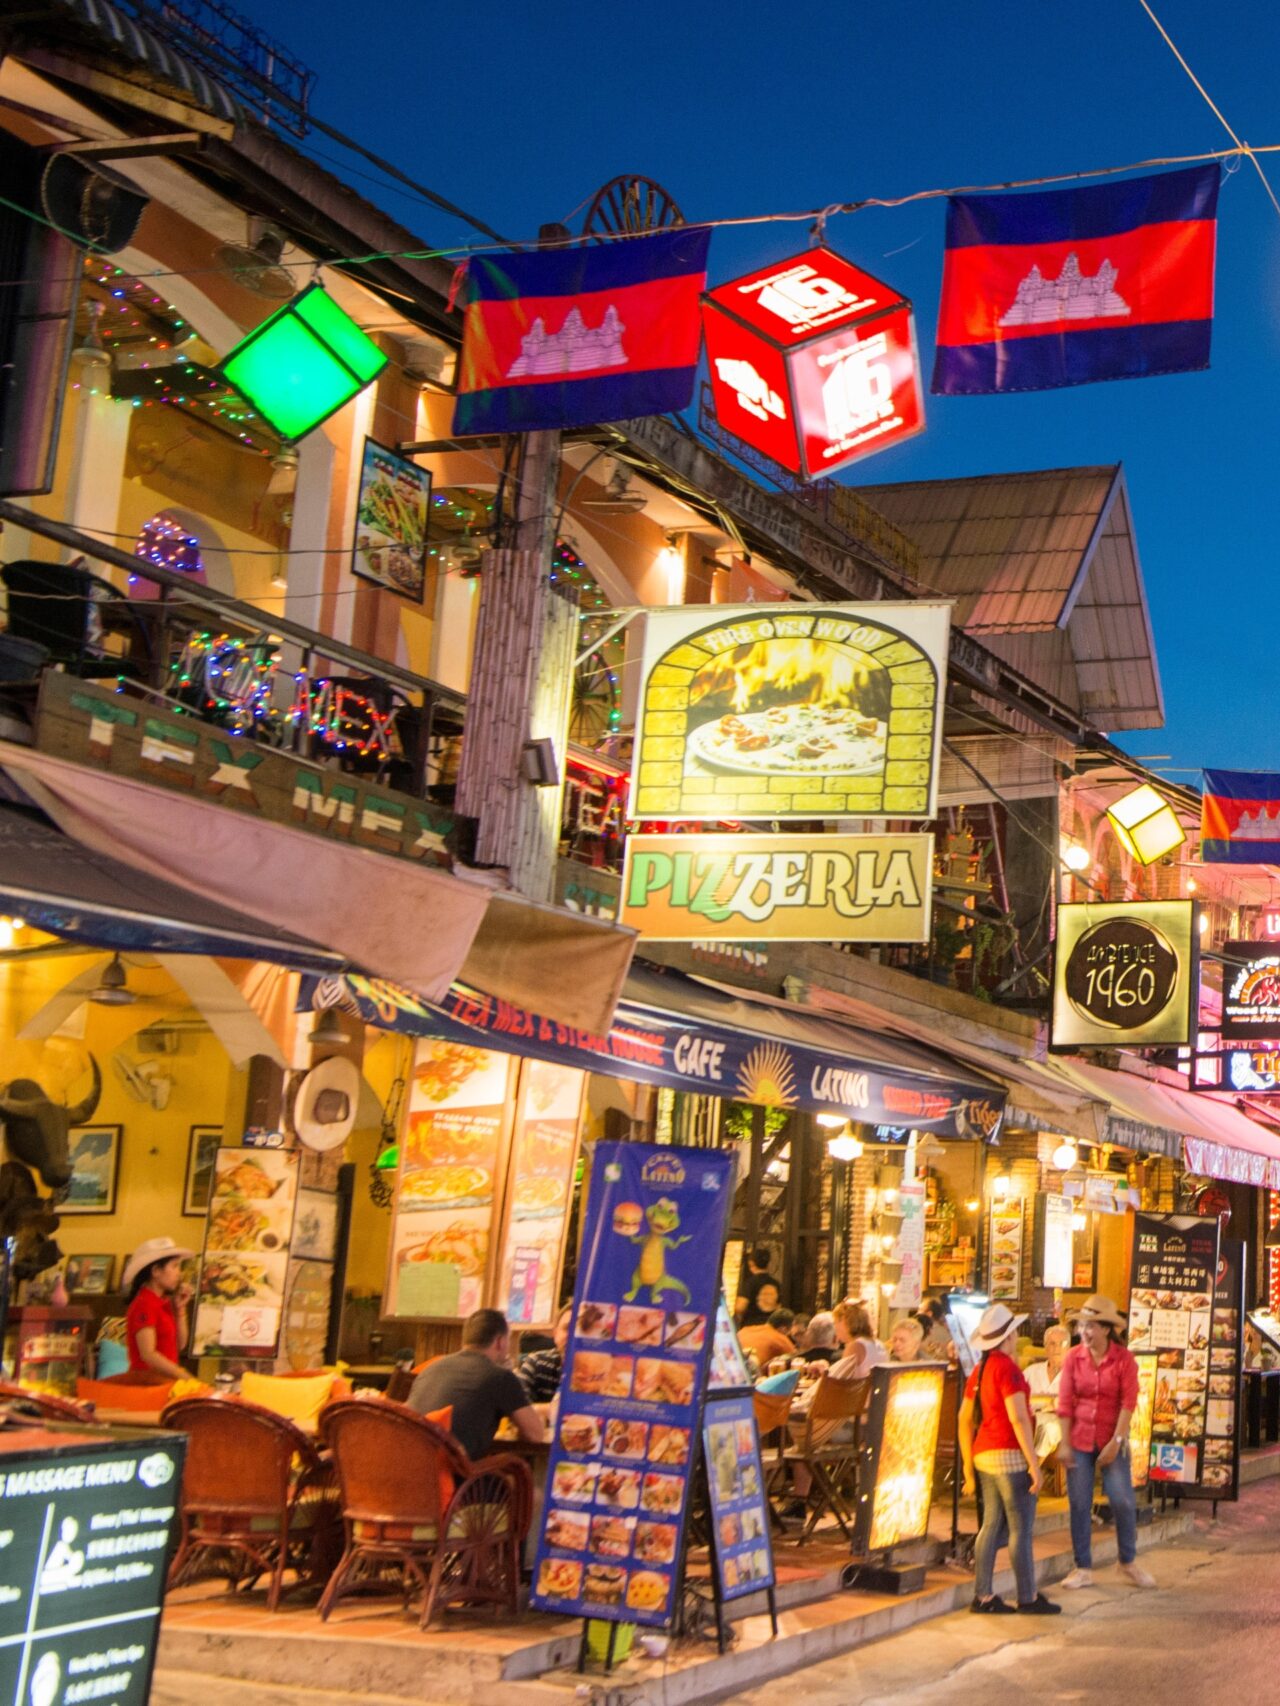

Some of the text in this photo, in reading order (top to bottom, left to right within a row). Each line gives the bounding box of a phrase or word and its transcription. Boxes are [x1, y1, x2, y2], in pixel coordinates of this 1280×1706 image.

[704, 618, 882, 654] FIRE OVEN WOOD
[70, 693, 264, 808] TEX
[294, 769, 456, 868] MEX
[627, 850, 924, 923] PIZZERIA
[1086, 963, 1155, 1009] 1960
[450, 992, 492, 1027] TEX
[493, 995, 536, 1040] MEX
[673, 1034, 727, 1081] CAFE
[811, 1065, 870, 1109] LATINO
[1138, 1243, 1158, 1253] MEX
[1139, 1234, 1158, 1244] TEX
[5, 1459, 138, 1497] MASSAGE MENU
